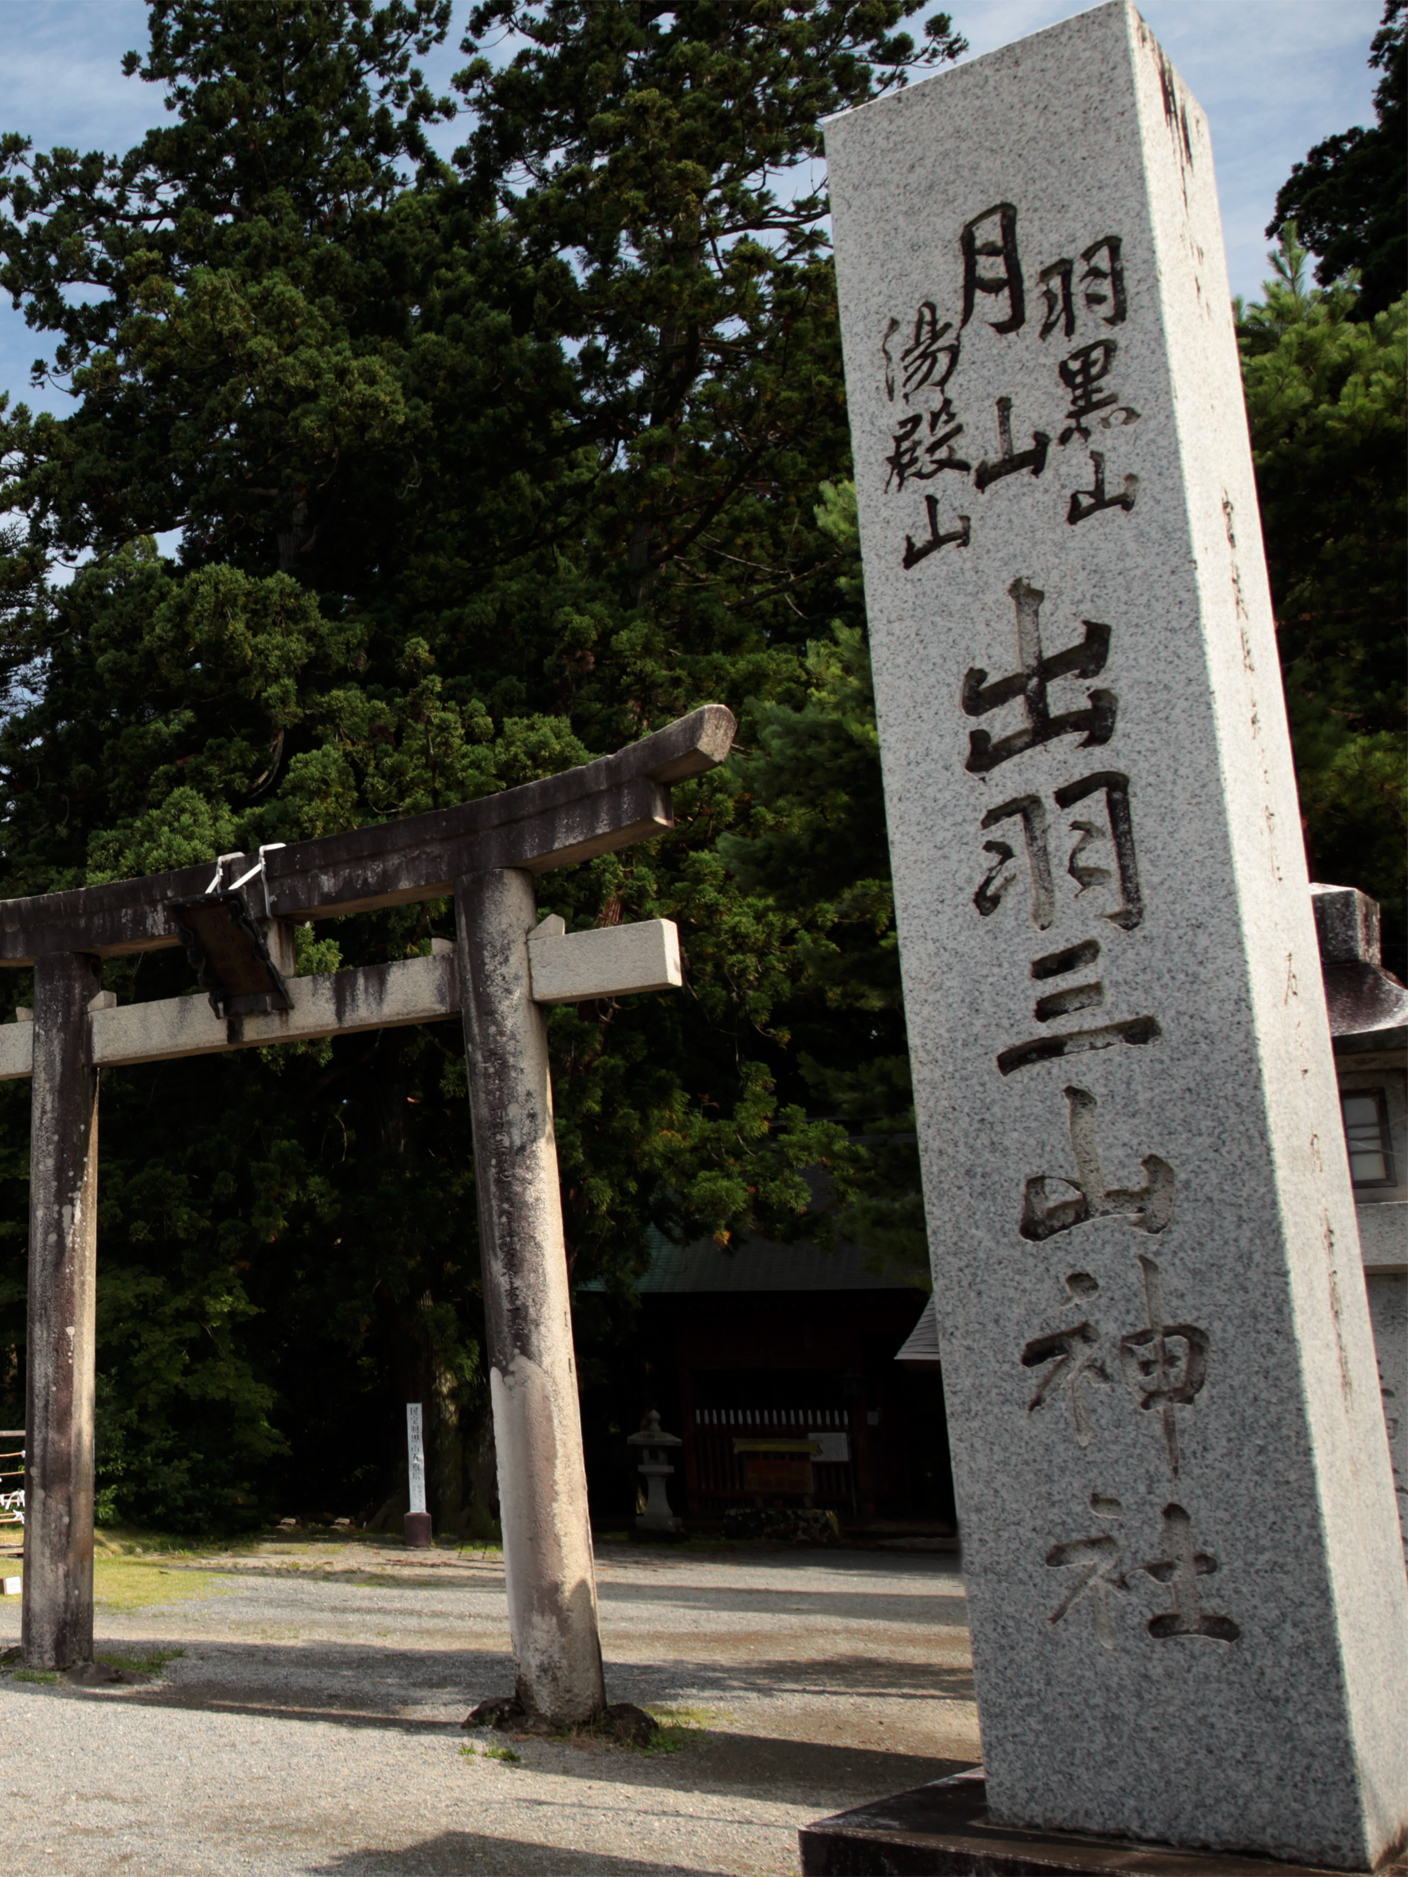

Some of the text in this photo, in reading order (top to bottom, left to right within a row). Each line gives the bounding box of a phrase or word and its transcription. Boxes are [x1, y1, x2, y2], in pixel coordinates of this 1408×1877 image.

[882, 301, 972, 570] 湯殿山
[959, 202, 1052, 494] 月山
[1038, 235, 1143, 526] 羽黒山
[961, 576, 1242, 1650] 出羽三山神社
